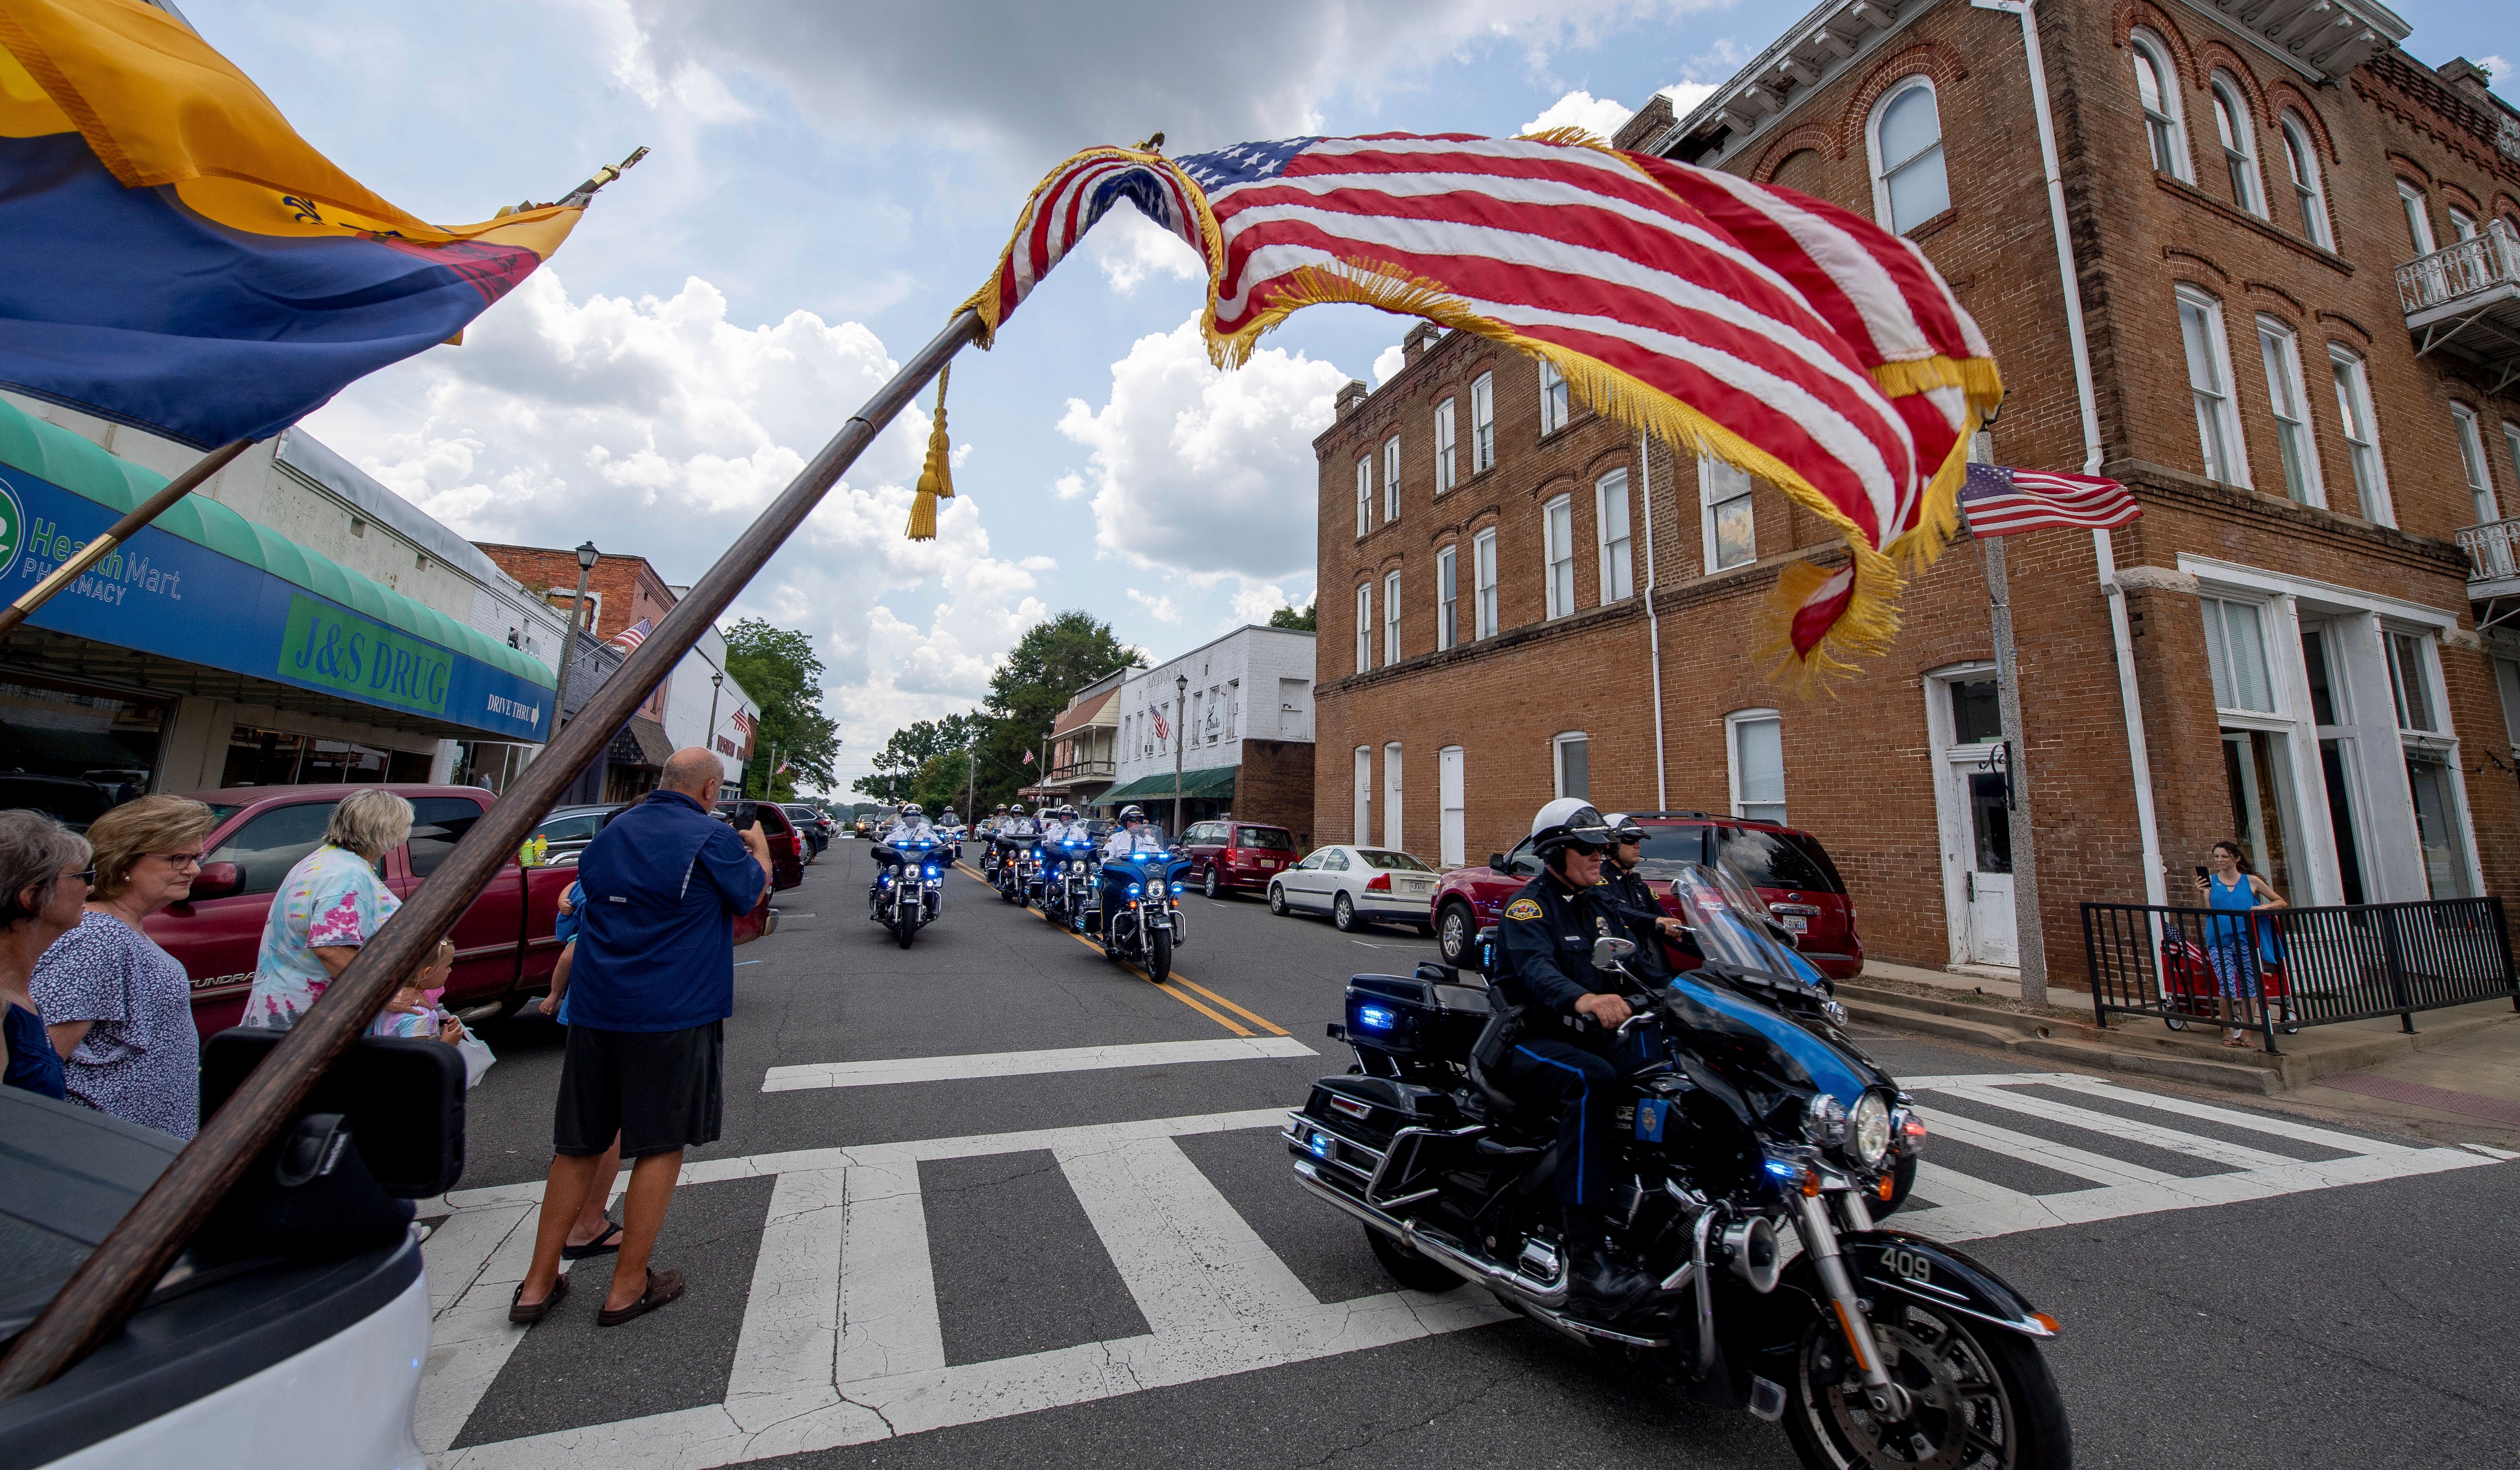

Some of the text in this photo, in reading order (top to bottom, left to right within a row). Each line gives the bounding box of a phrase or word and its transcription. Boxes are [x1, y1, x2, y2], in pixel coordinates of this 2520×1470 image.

[29, 517, 123, 580] Heath
[295, 615, 448, 705] J&S DRUG
[487, 694, 532, 721] DRIVE THRU
[1880, 1247, 1930, 1283] 409
